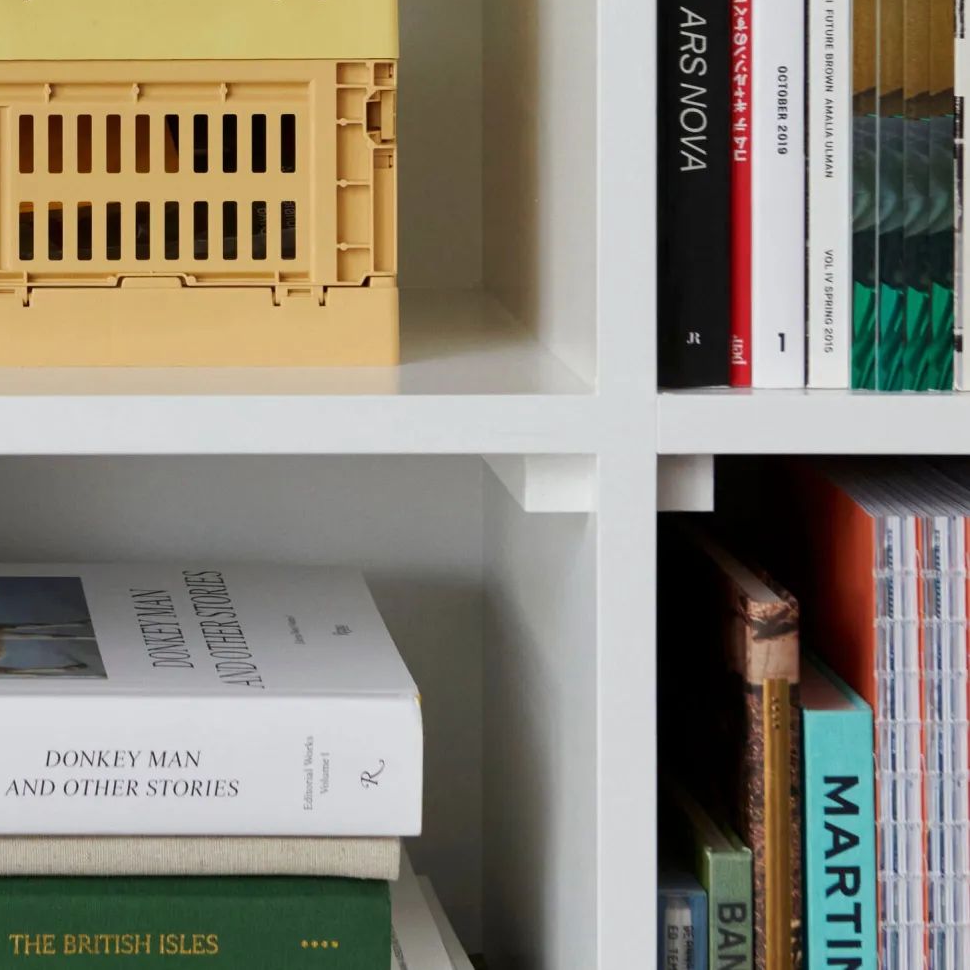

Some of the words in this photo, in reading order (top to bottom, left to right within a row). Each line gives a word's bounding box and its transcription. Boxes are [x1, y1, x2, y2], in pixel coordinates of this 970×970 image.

[678, 6, 707, 76] ARS
[825, 9, 834, 49] FUTURE
[825, 53, 834, 92] BROWN
[777, 66, 787, 120] OCTOBER
[678, 84, 707, 172] NOVA
[825, 98, 834, 137] AMALIA
[777, 126, 787, 156] 2019
[825, 141, 834, 178] ULMAN
[825, 250, 834, 270] VOL
[825, 286, 834, 325] SPRING
[777, 332, 786, 352] 1
[825, 328, 834, 353] 2015
[130, 589, 177, 617] MAN
[182, 570, 237, 618] STORIES
[138, 619, 194, 668] DONKEY
[200, 621, 253, 659] OTHER
[215, 661, 265, 689] AND
[45, 749, 141, 770] DONKEY
[149, 749, 201, 770] MAN
[303, 736, 313, 766] Works
[5, 778, 57, 799] AND
[63, 778, 140, 799] OTHER
[146, 778, 240, 799] STORIES
[303, 769, 313, 810] Editorial
[320, 758, 329, 794] Volume
[9, 932, 55, 956] THE
[63, 932, 151, 956] BRITISH
[159, 932, 218, 956] ISLES
